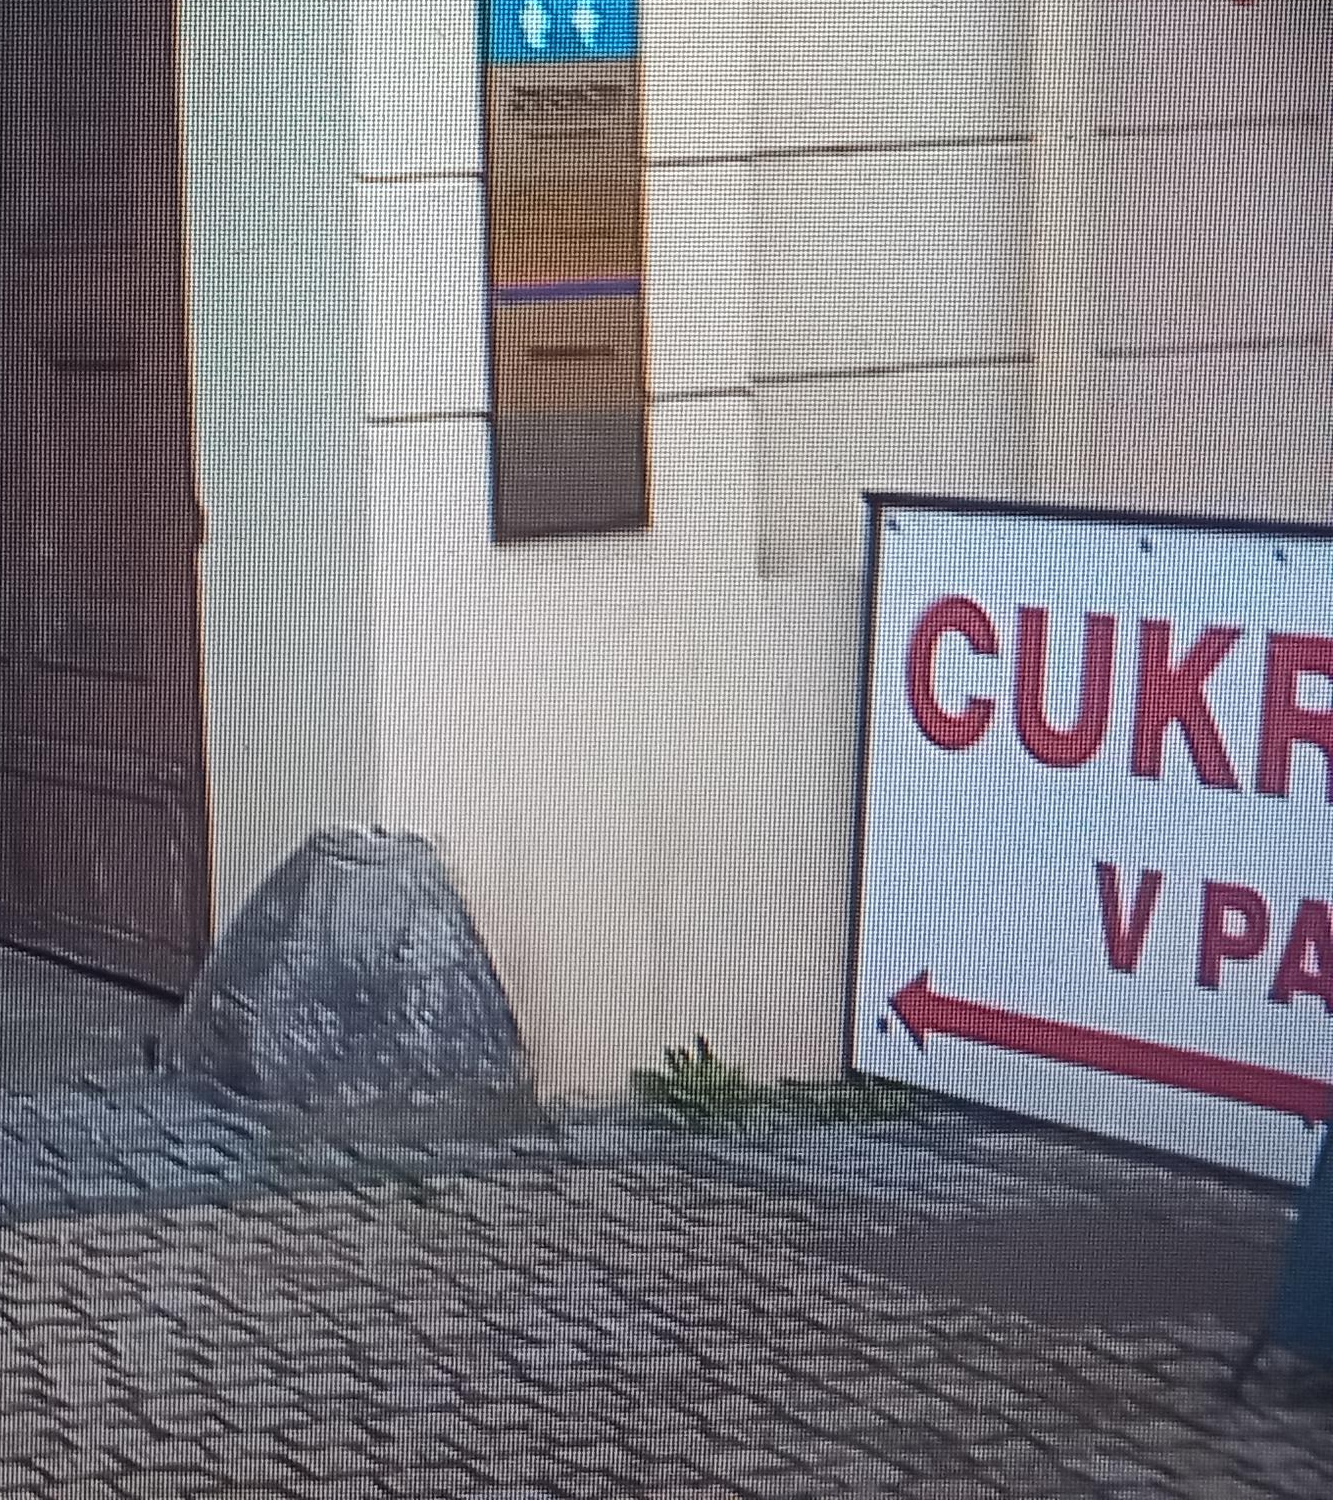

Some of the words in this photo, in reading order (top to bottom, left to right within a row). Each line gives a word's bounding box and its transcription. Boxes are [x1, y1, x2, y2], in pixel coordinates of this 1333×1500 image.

[904, 593, 1332, 804] CUKR
[1096, 861, 1161, 974] V
[1196, 879, 1332, 1016] PA
